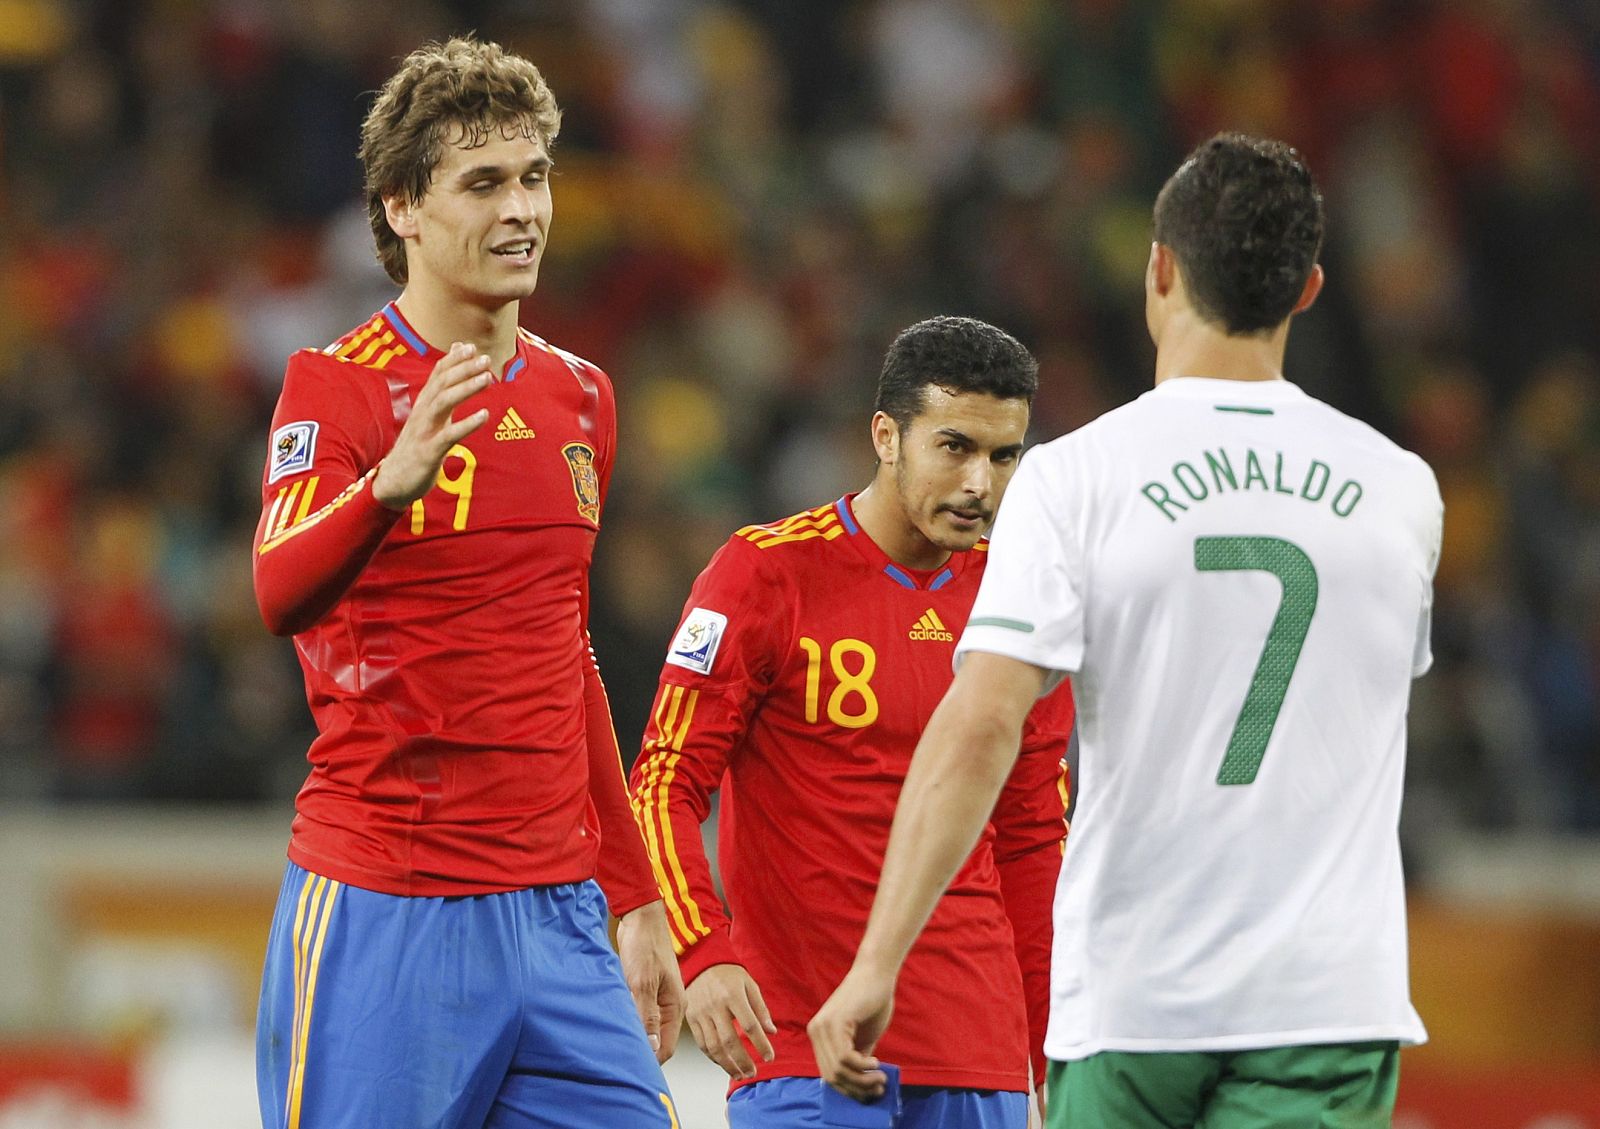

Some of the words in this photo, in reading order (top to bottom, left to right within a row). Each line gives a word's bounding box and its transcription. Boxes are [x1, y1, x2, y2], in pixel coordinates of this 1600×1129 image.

[494, 427, 536, 441] adidas
[1141, 447, 1363, 522] RONALDO
[908, 627, 954, 642] adidas
[1194, 535, 1319, 786] 7
[799, 636, 879, 729] 18
